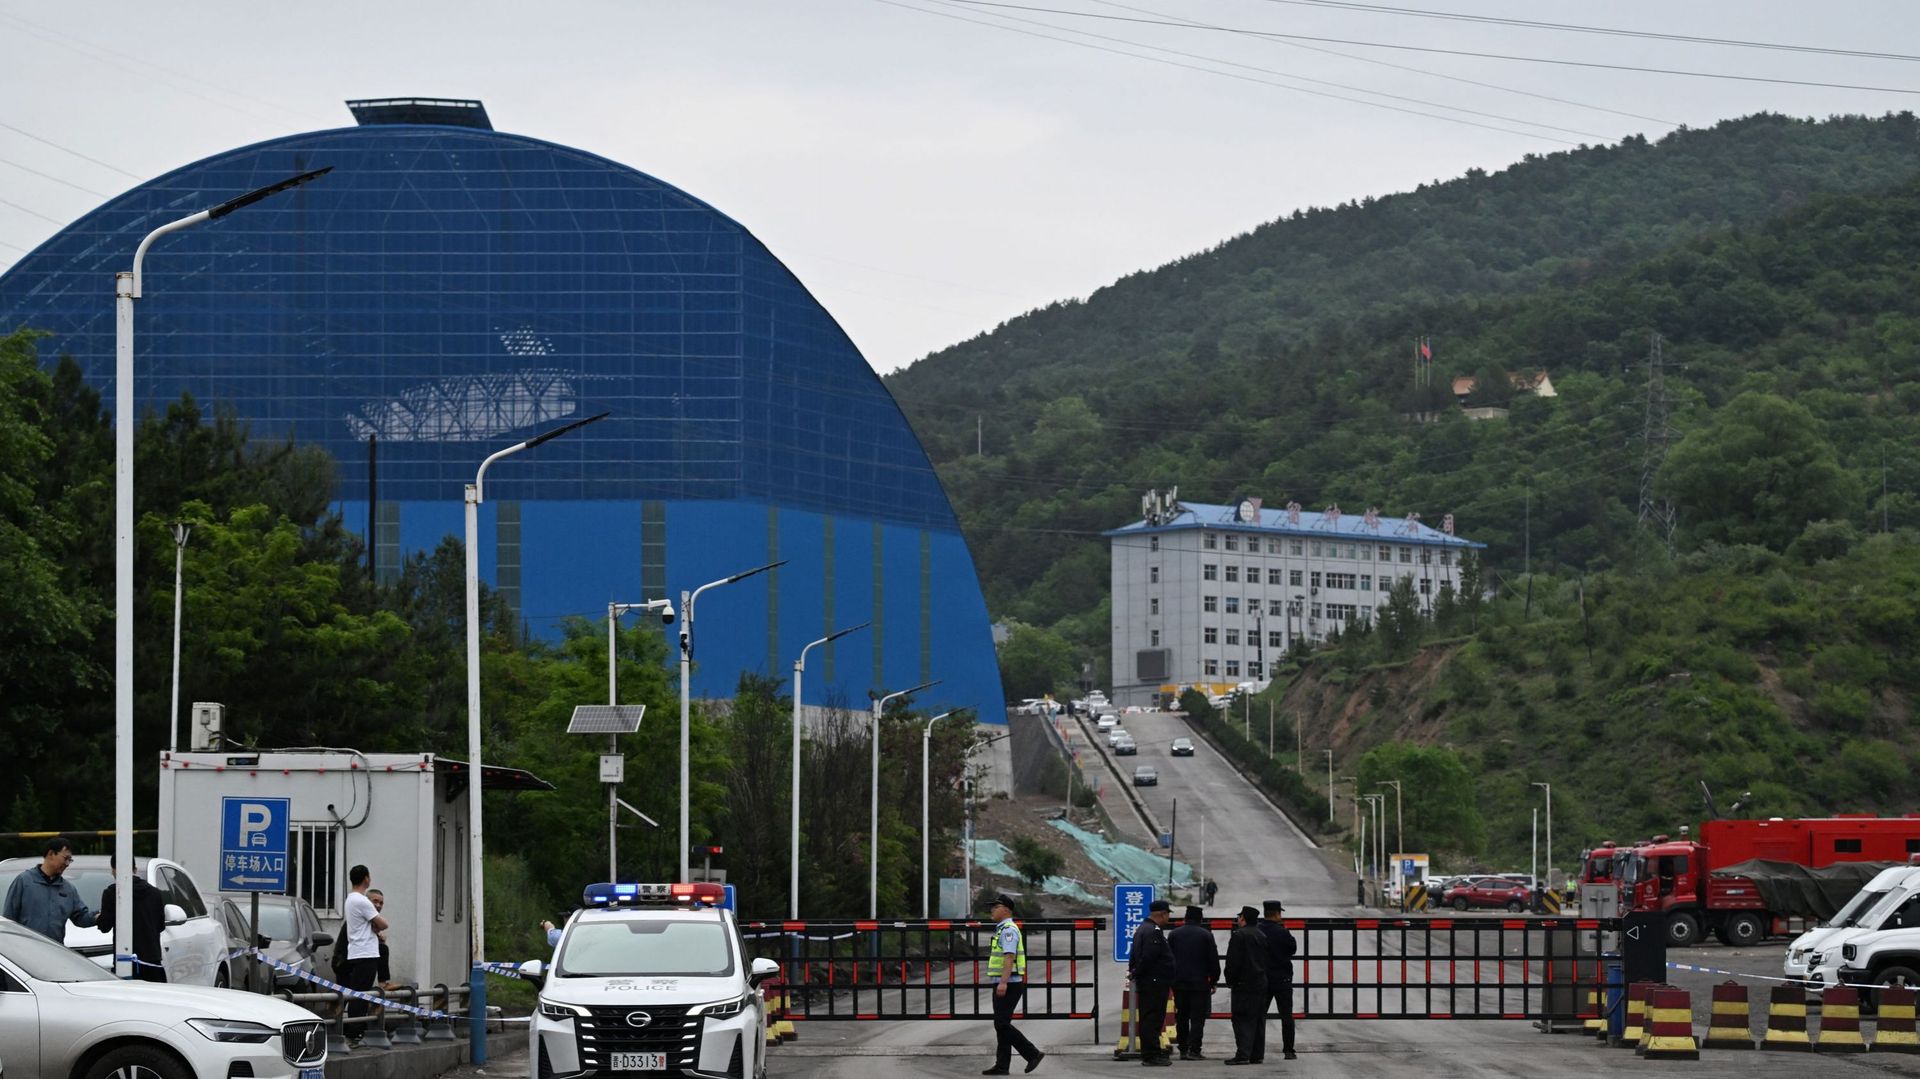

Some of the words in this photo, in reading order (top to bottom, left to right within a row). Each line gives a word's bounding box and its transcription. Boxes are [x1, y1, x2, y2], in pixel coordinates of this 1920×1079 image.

[239, 803, 272, 848] P
[225, 854, 284, 873] 停车场入口
